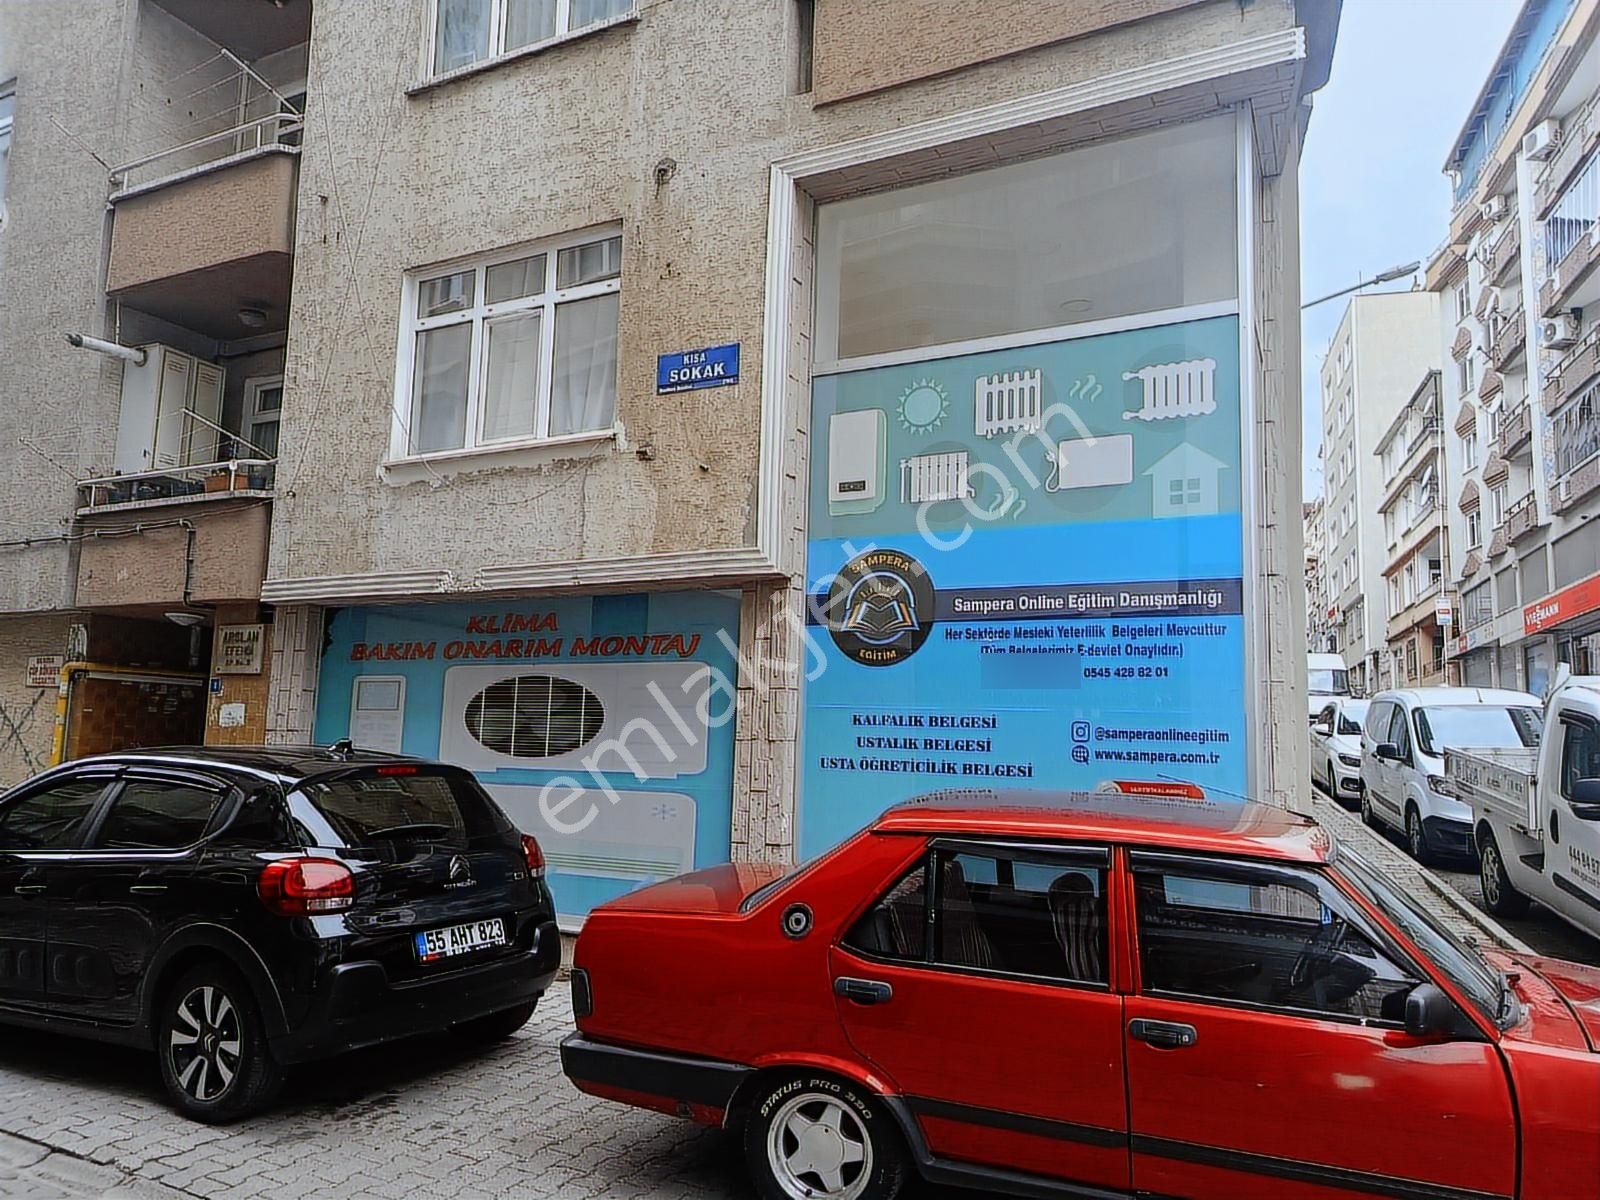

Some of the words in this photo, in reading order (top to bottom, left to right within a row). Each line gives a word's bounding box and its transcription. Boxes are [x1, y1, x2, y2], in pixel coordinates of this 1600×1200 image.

[683, 352, 706, 365] KISA
[669, 362, 725, 383] SOKAK
[850, 553, 911, 574] SAMPERA
[954, 598, 1015, 614] Sampera
[1018, 595, 1064, 611] Online
[1067, 592, 1115, 612] Eğitim
[1119, 589, 1223, 610] Danışmanlığı
[944, 627, 962, 640] Her
[965, 627, 1010, 640] Sektörde
[1013, 626, 1054, 639] Mesleki
[1057, 624, 1106, 639] Yeterlilik
[1111, 623, 1163, 640] Belgeleri
[1166, 623, 1227, 637] Mevcuttur
[350, 640, 436, 661] BAKIM
[442, 637, 563, 660] ONARIM
[569, 633, 701, 658] MONTAJ
[1077, 643, 1121, 656] E-devlet
[1083, 667, 1111, 678] 0545
[1114, 667, 1134, 678] 428
[1137, 667, 1152, 678] 82
[1155, 666, 1169, 677] 01
[852, 714, 924, 728] KALFALIK
[928, 713, 997, 729] BELGESİ
[856, 736, 918, 750] USTALIK
[923, 737, 992, 752] BELGESİ
[1094, 726, 1229, 745] @samperaonlineegitim
[1095, 749, 1220, 765] www.sampera.com.tr
[820, 757, 856, 770] USTA
[859, 756, 958, 775] ÖĞRETİCİLİK
[962, 762, 1033, 778] BELGESİ
[425, 931, 447, 952] 55
[450, 925, 476, 945] AHT
[479, 920, 504, 941] 823
[760, 1079, 802, 1117] STATUS
[810, 1079, 841, 1092] PRO
